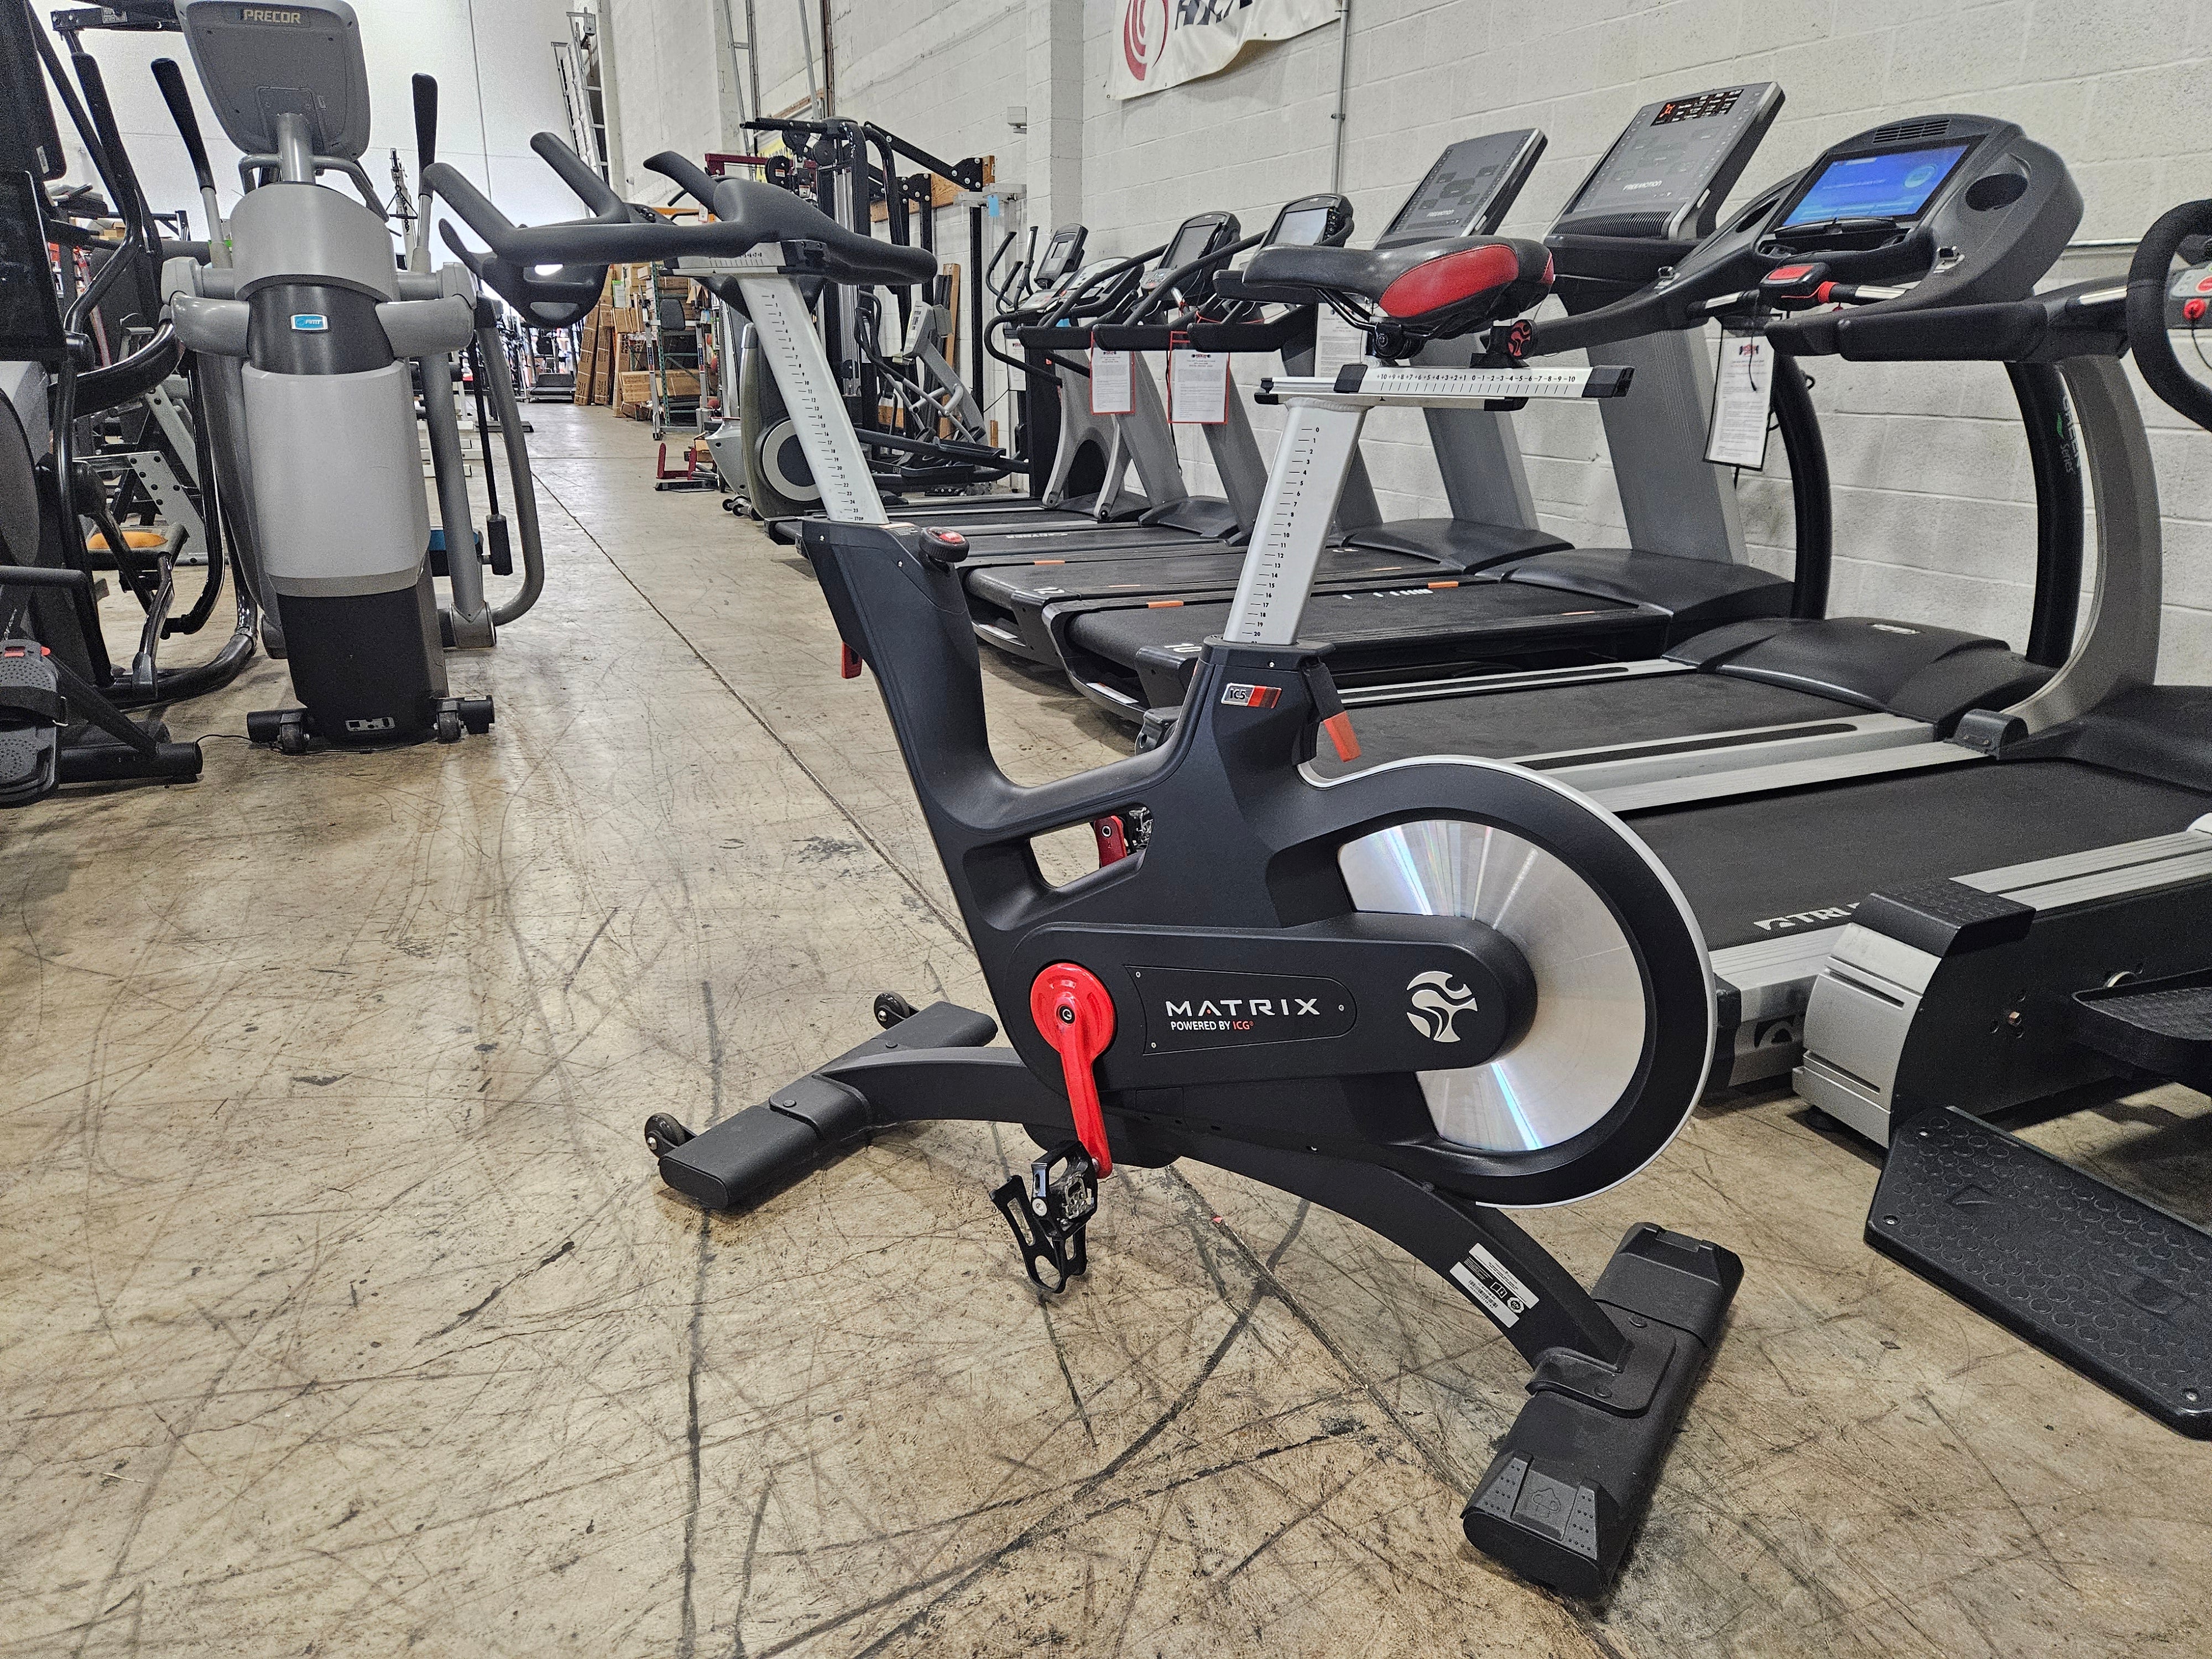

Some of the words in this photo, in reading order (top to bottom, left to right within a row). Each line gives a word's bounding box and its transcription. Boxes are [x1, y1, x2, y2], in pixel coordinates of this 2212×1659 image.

[243, 9, 301, 23] PRECOR
[1166, 999, 1320, 1016] MATRIX
[1170, 1021, 1217, 1030] POWERED
[1218, 1021, 1230, 1030] BY
